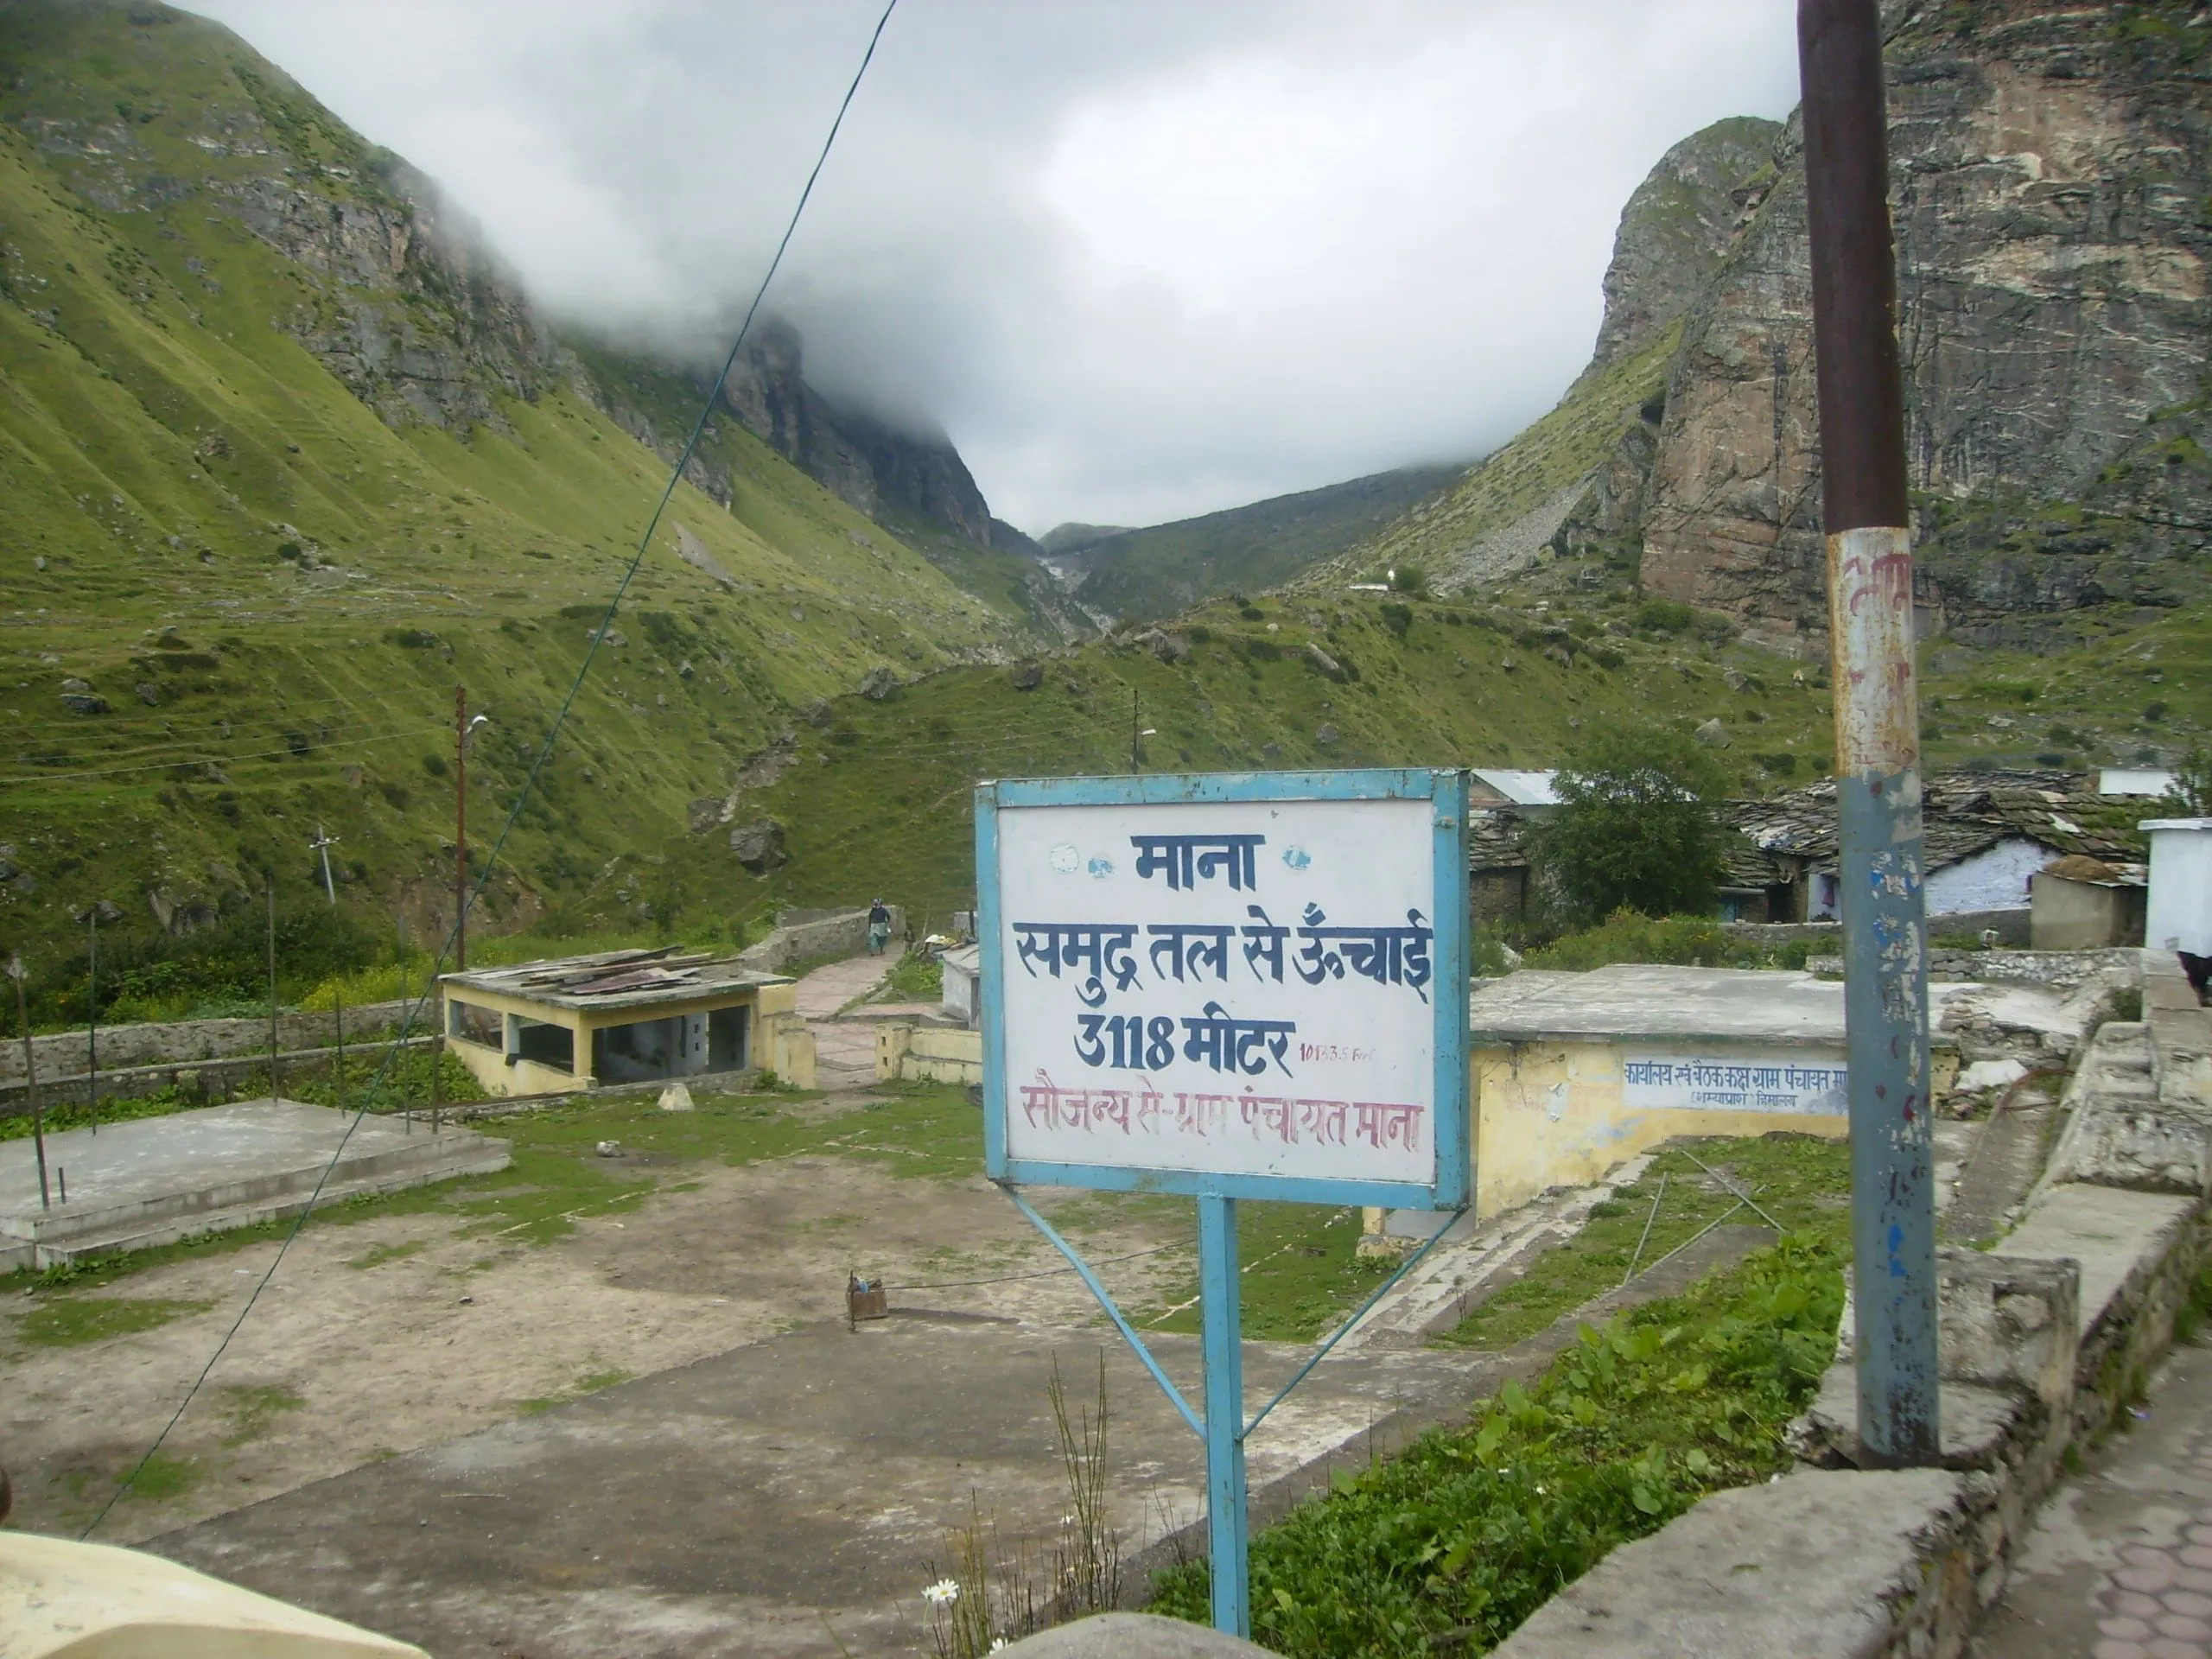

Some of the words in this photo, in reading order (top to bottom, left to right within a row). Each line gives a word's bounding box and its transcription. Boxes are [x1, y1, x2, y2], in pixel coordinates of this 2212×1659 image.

[1130, 835, 1266, 892] माना
[1013, 922, 1143, 1008] समुद्र
[1147, 925, 1236, 983] तल
[1240, 905, 1290, 984] से
[1292, 902, 1433, 1004] ऊँचाई
[1074, 1014, 1175, 1071] 3118
[1181, 1001, 1296, 1078] मीटर
[1624, 1060, 1674, 1087] कार्यालय
[1752, 1067, 1782, 1090] ग्राम
[1783, 1064, 1830, 1091] पंचायत
[1019, 1067, 1133, 1135] सौजन्य
[1237, 1085, 1349, 1147] पंचायत
[1352, 1102, 1425, 1153] माना
